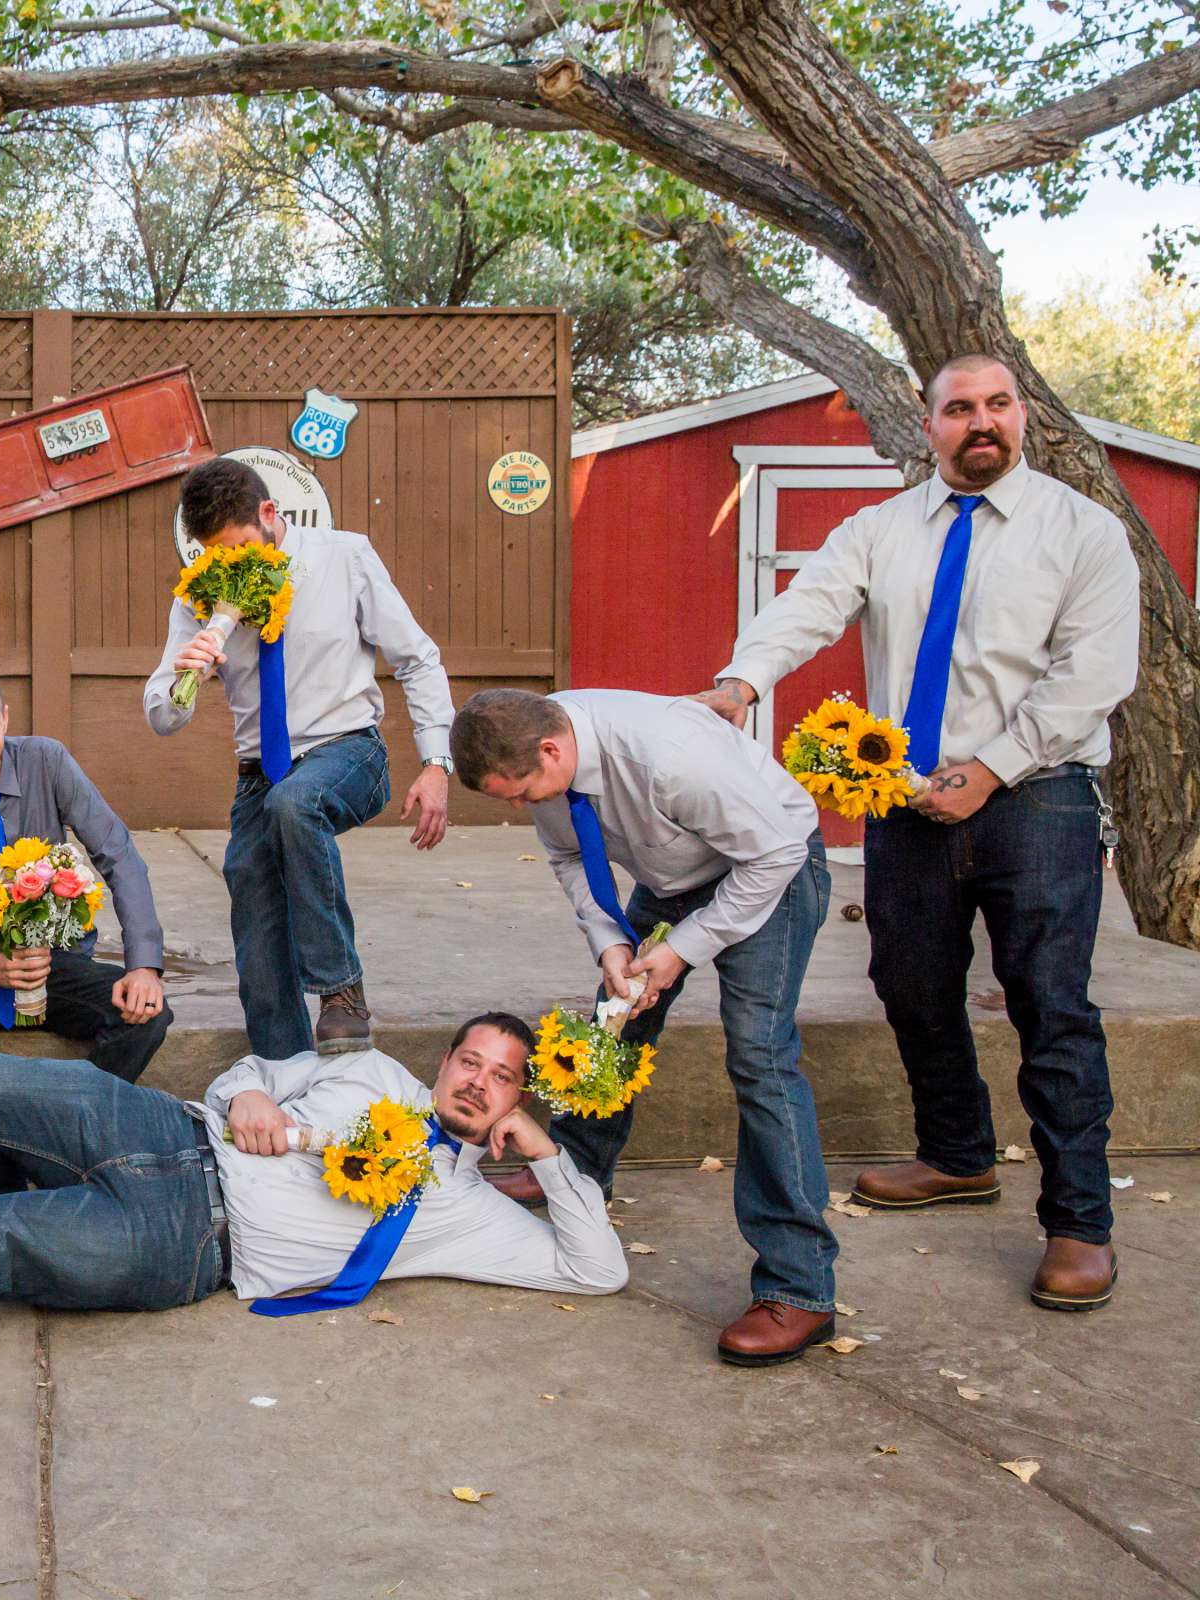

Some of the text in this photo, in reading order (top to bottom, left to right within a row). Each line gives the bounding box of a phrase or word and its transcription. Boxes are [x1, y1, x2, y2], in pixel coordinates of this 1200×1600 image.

[306, 407, 345, 431] ROUTE
[71, 420, 103, 441] 9958
[298, 421, 338, 454] 66
[499, 453, 540, 468] WE USE
[286, 465, 312, 494] Quality
[502, 498, 537, 511] PARTS
